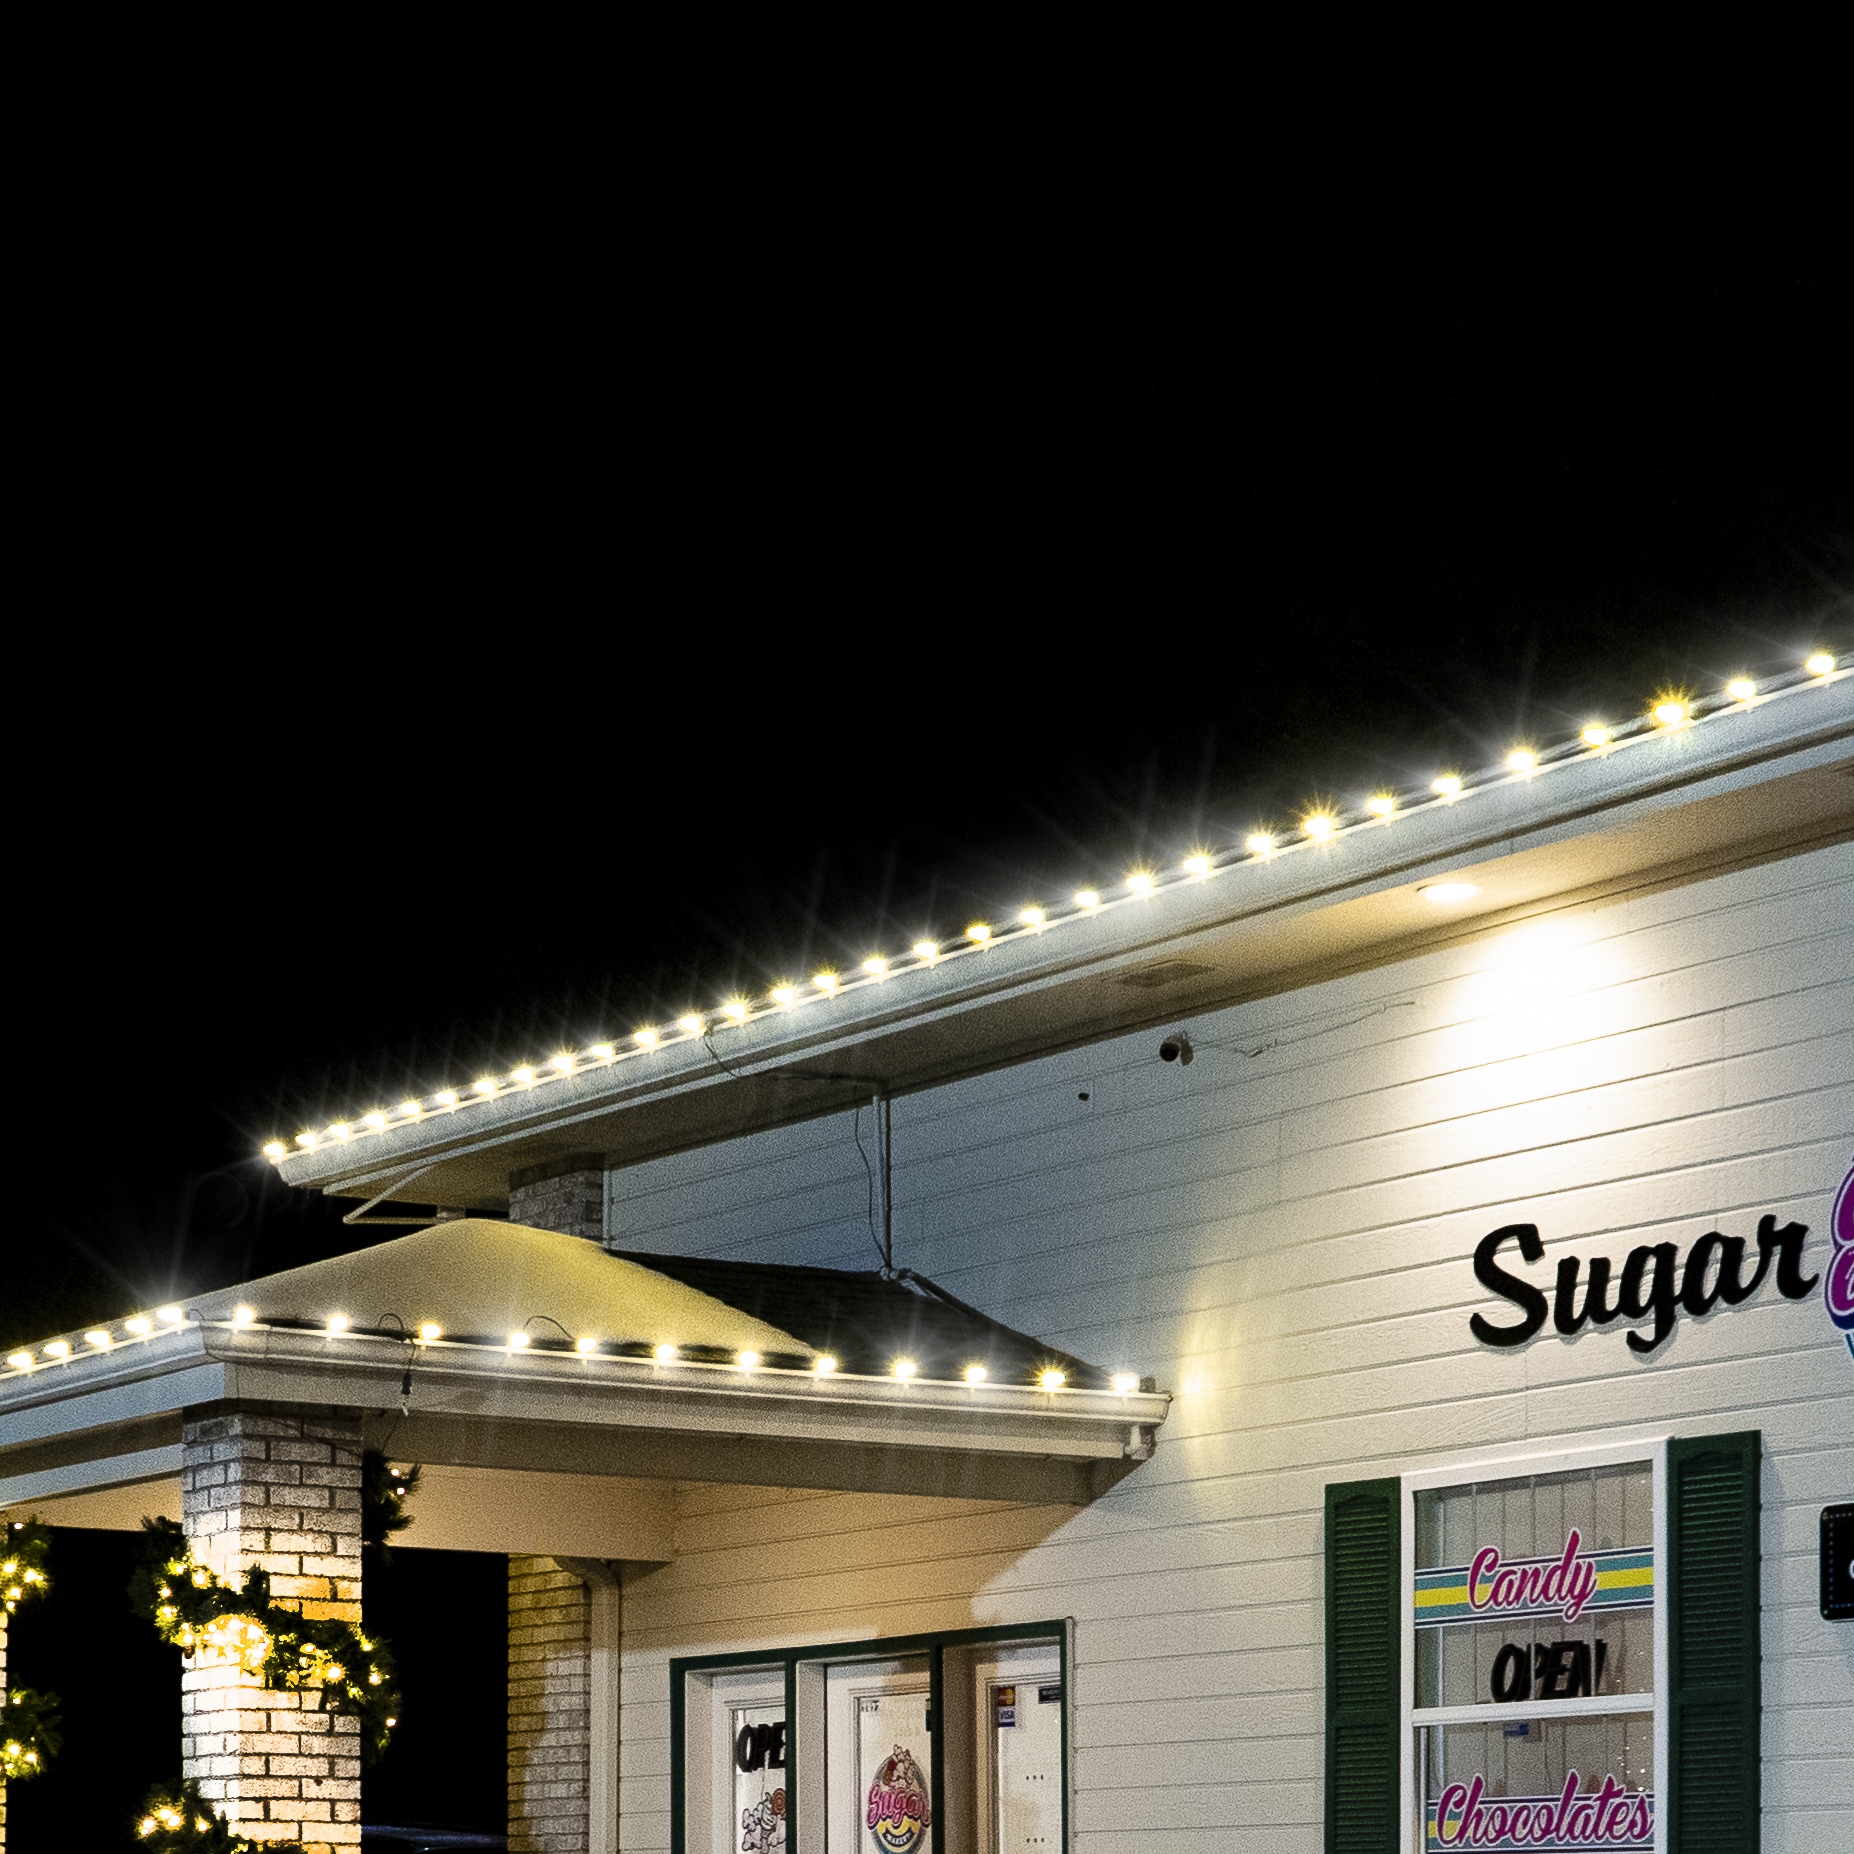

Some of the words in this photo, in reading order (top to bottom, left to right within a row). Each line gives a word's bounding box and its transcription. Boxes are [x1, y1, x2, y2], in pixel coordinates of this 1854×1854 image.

[1469, 1214, 1818, 1353] Sugar
[1468, 1527, 1598, 1622] Candy
[1490, 1639, 1608, 1702] OPEN
[737, 1721, 786, 1773] OPE
[867, 1782, 931, 1830] Sugar
[1436, 1768, 1654, 1848] Chocolates
